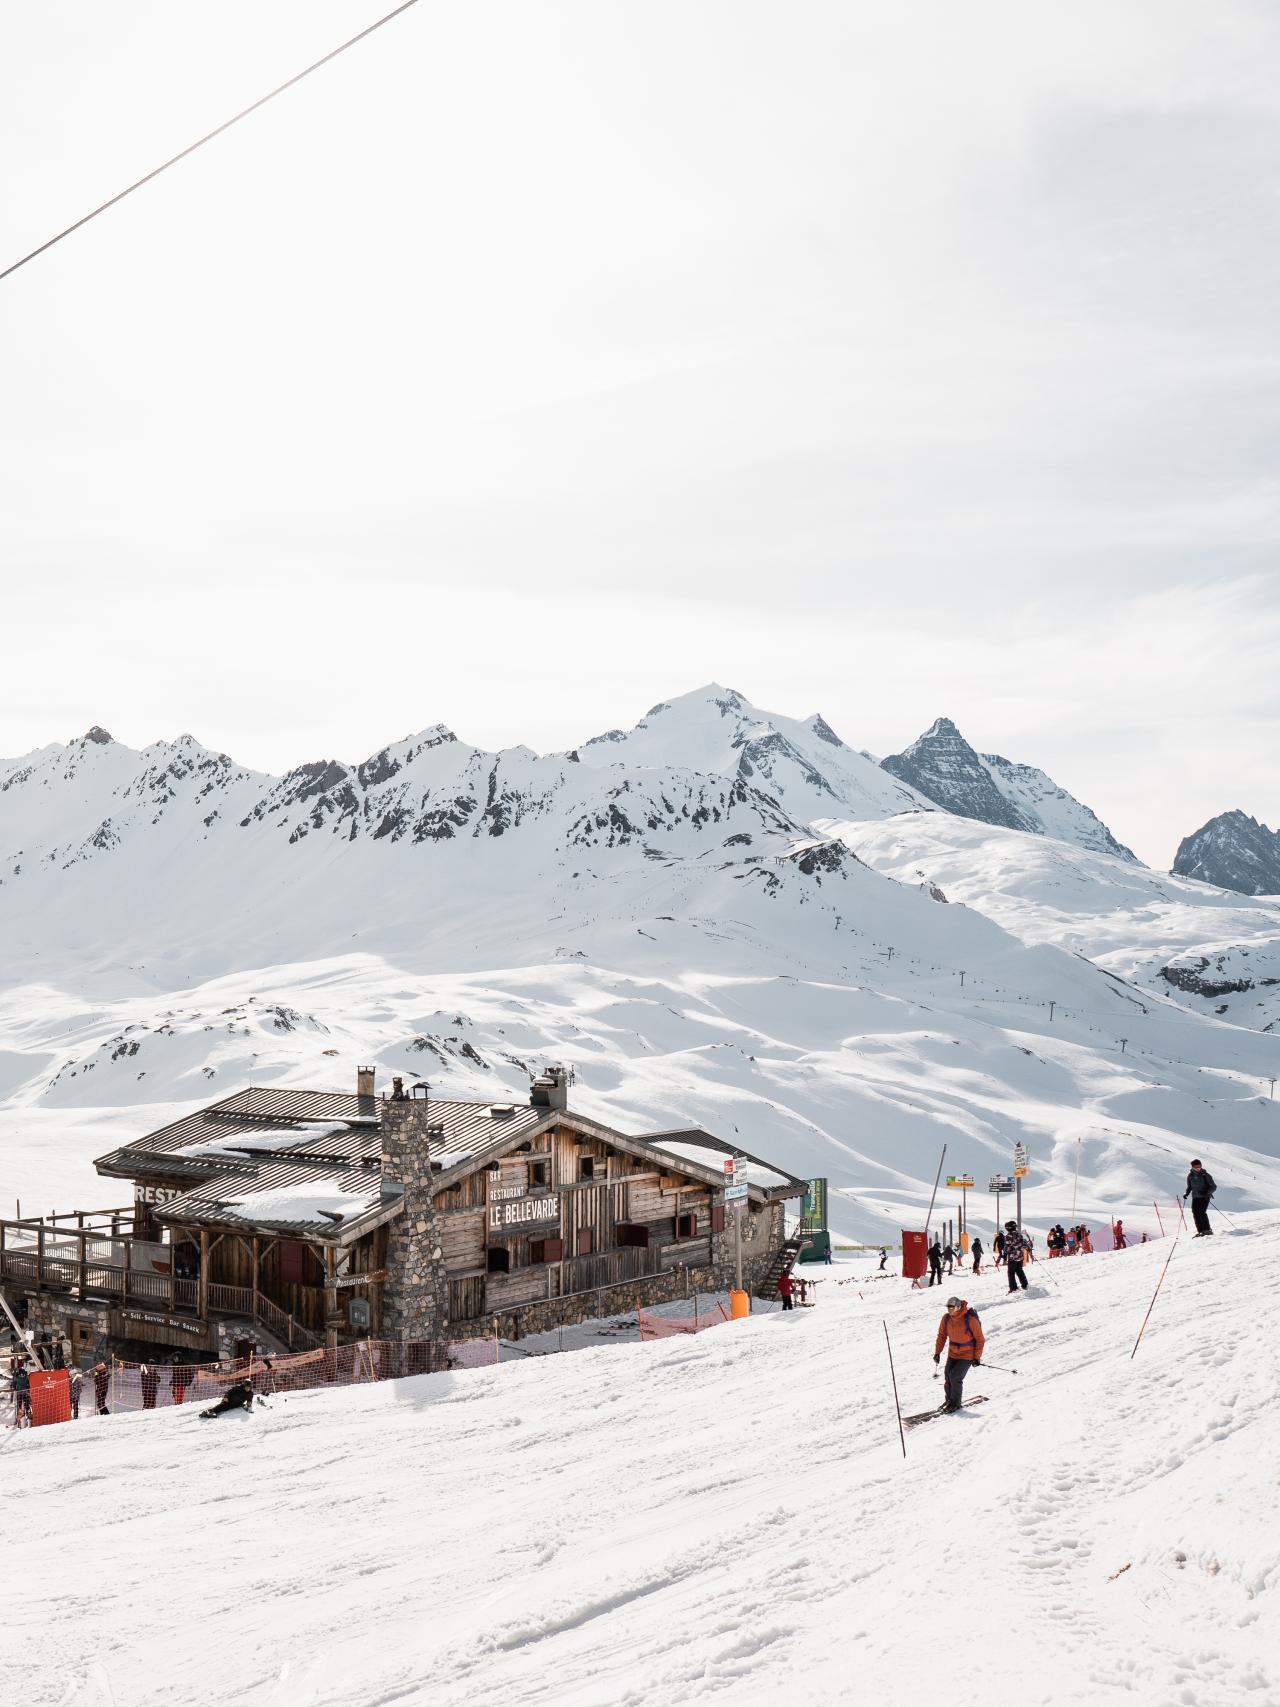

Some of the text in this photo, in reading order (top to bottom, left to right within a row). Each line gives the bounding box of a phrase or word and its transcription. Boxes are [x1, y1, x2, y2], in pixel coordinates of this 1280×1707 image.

[490, 1171, 501, 1182] BAR
[490, 1187, 524, 1200] RESTAURANT
[490, 1198, 558, 1226] LE BELLEVARDE
[130, 1312, 165, 1324] Self-Service
